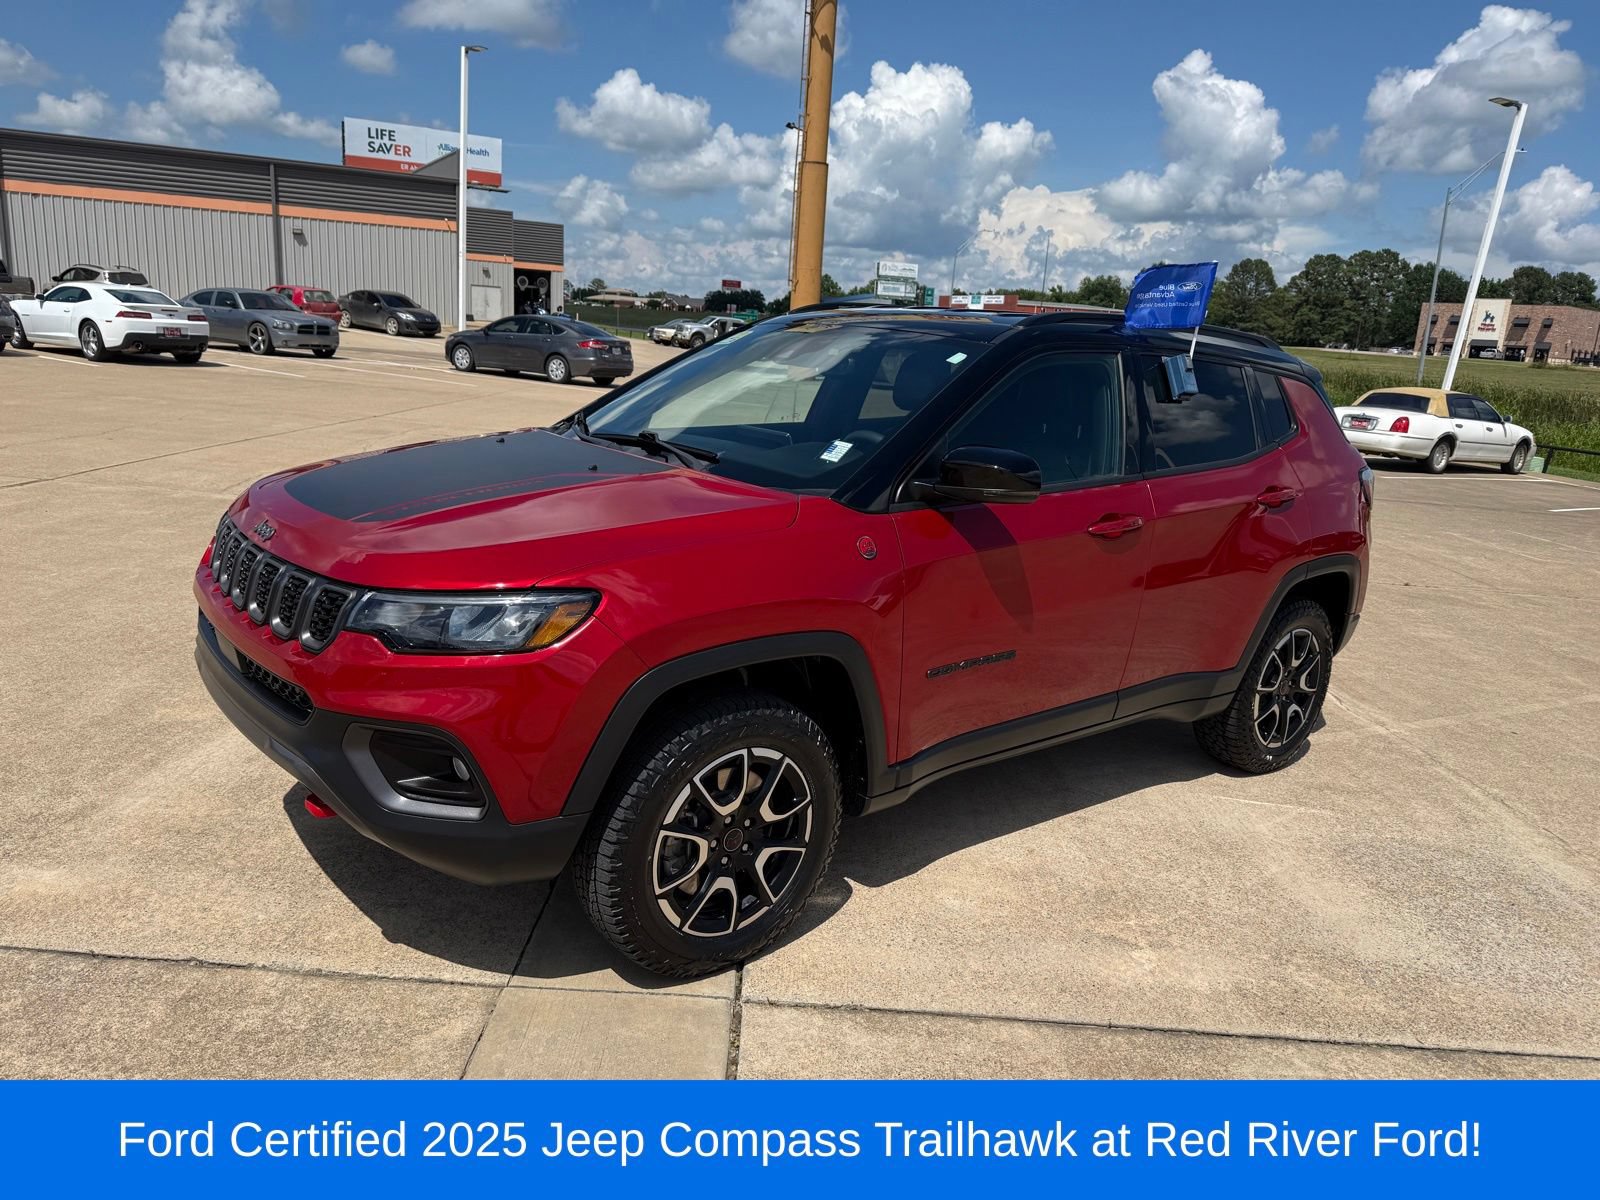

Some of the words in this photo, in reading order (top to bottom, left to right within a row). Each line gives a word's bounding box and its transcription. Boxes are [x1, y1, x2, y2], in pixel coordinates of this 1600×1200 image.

[368, 127, 396, 141] LIFE
[368, 142, 411, 157] SAVER
[467, 147, 490, 157] Health
